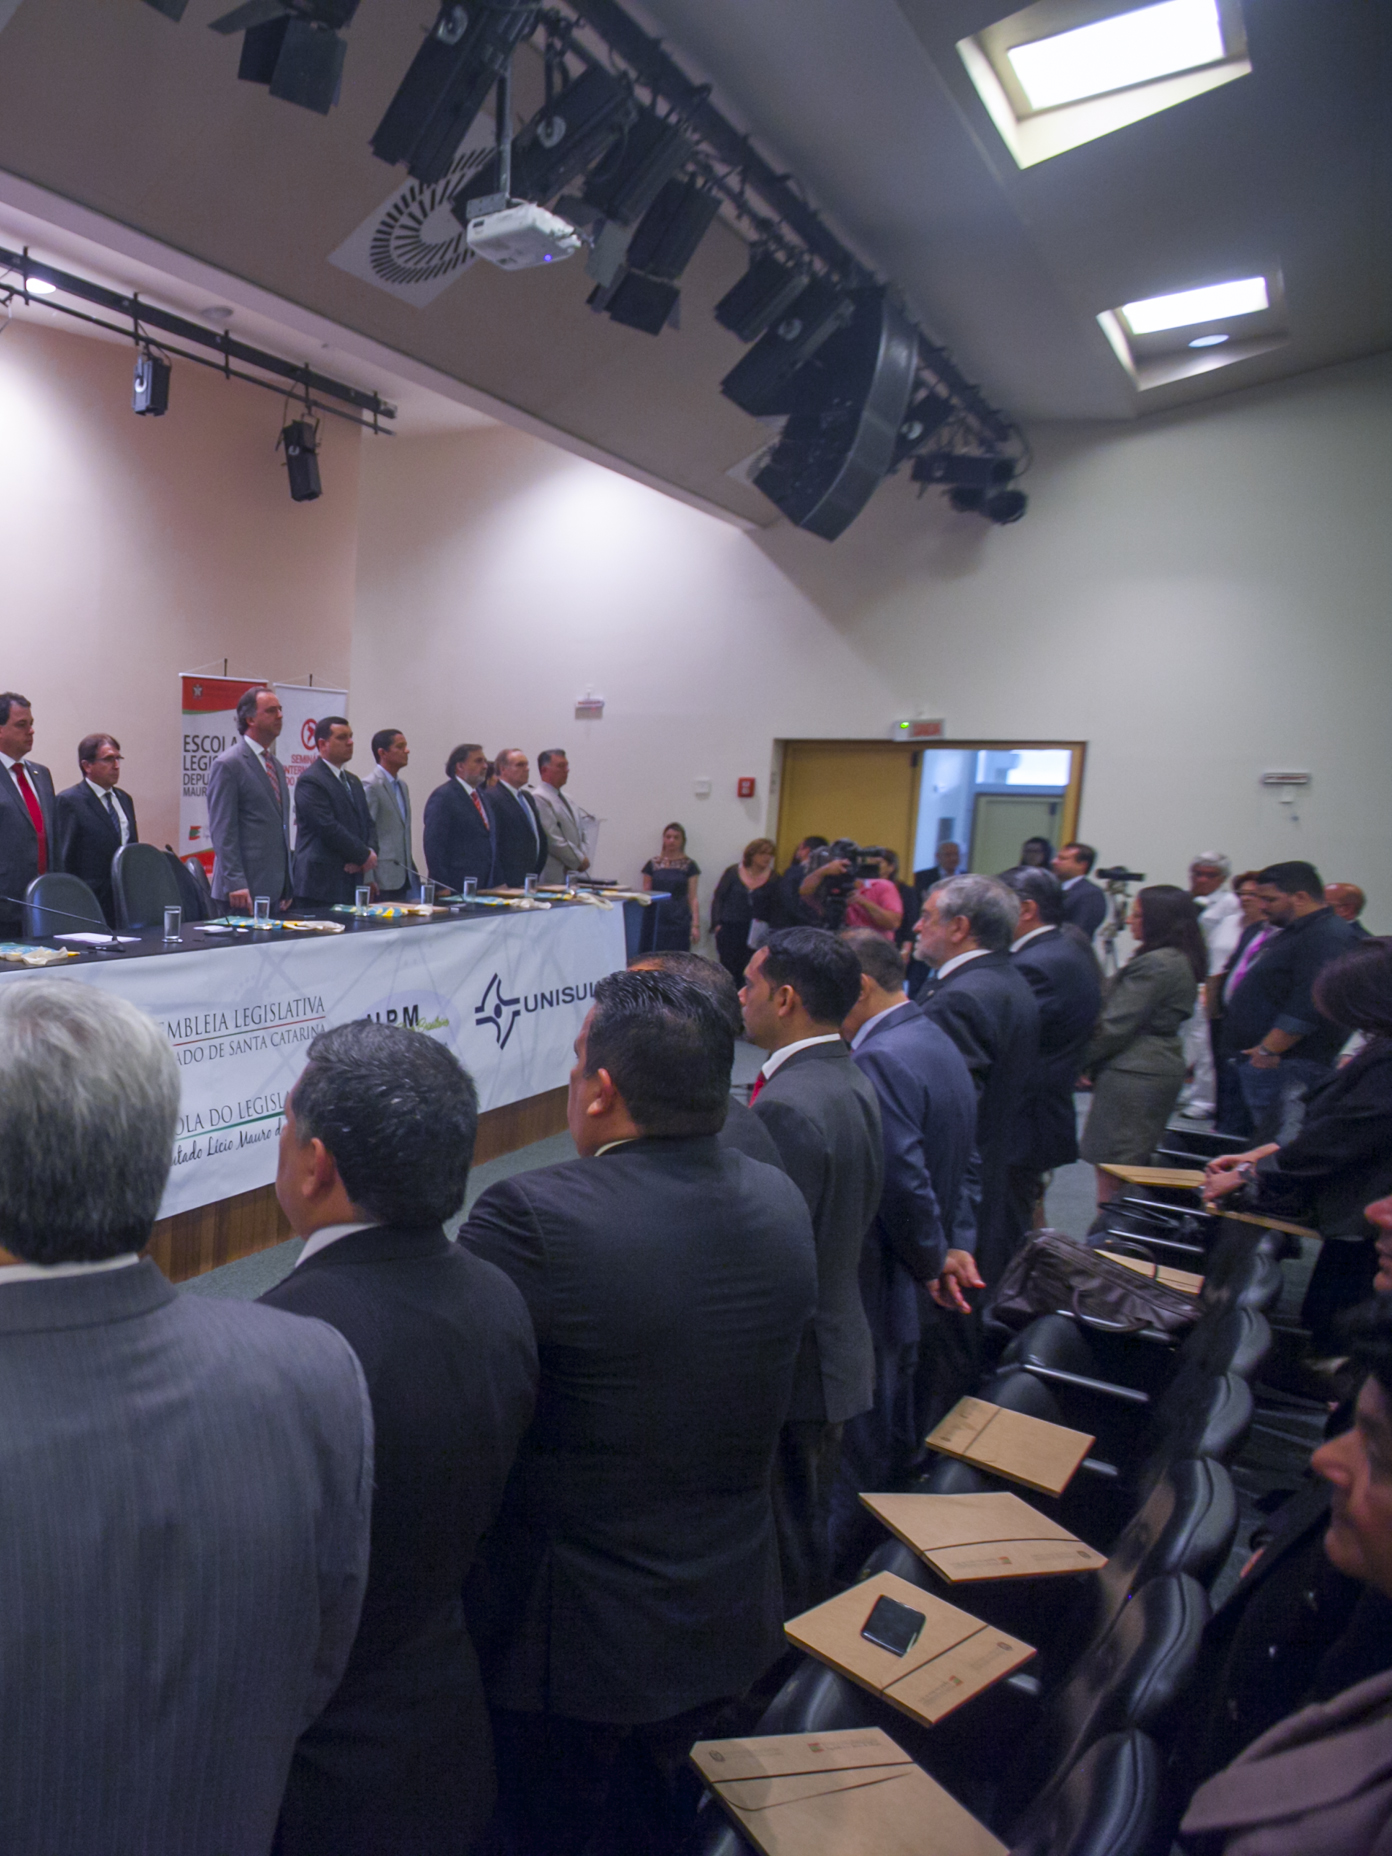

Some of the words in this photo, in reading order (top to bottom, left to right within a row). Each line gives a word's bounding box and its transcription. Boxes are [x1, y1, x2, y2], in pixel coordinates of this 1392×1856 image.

[183, 786, 208, 797] MAUR
[160, 1012, 229, 1039] MBLEIA
[234, 995, 326, 1029] LEGISLATIVA
[524, 982, 596, 1013] UNISUL
[208, 1042, 225, 1060] DE
[229, 1035, 268, 1056] SANTA
[270, 1023, 326, 1047] CATARINA
[175, 1112, 205, 1136] OLA
[208, 1104, 233, 1127] DO
[237, 1091, 289, 1120] LEGISL
[171, 1140, 203, 1167] utado
[206, 1135, 234, 1157] Lício
[235, 1129, 272, 1151] Mauro
[274, 1117, 282, 1137] d
